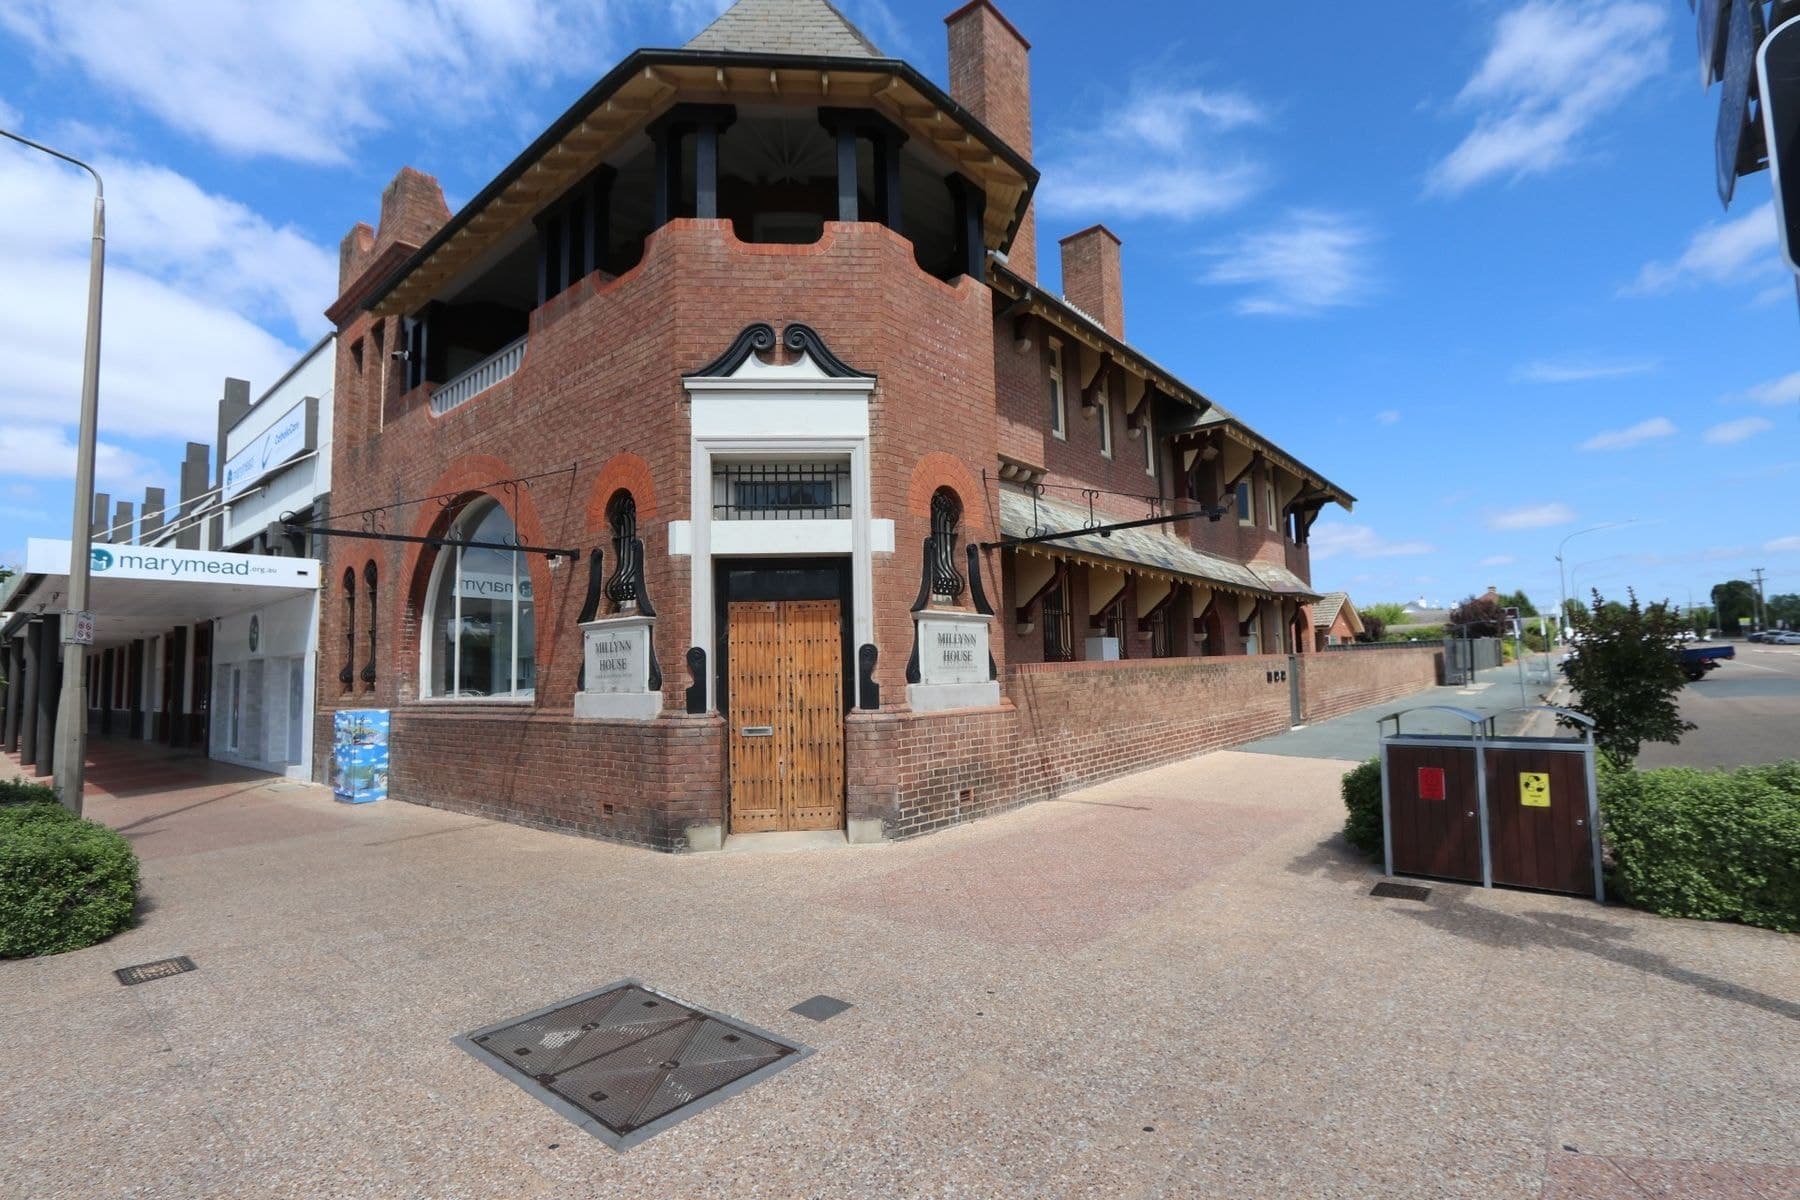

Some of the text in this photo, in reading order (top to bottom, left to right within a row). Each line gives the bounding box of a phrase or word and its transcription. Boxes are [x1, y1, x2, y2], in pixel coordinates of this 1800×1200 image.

[937, 632, 977, 645] MILLYNN
[595, 640, 632, 654] MILLYNN
[943, 650, 974, 662] HOUSE
[599, 658, 628, 671] HOUSE
